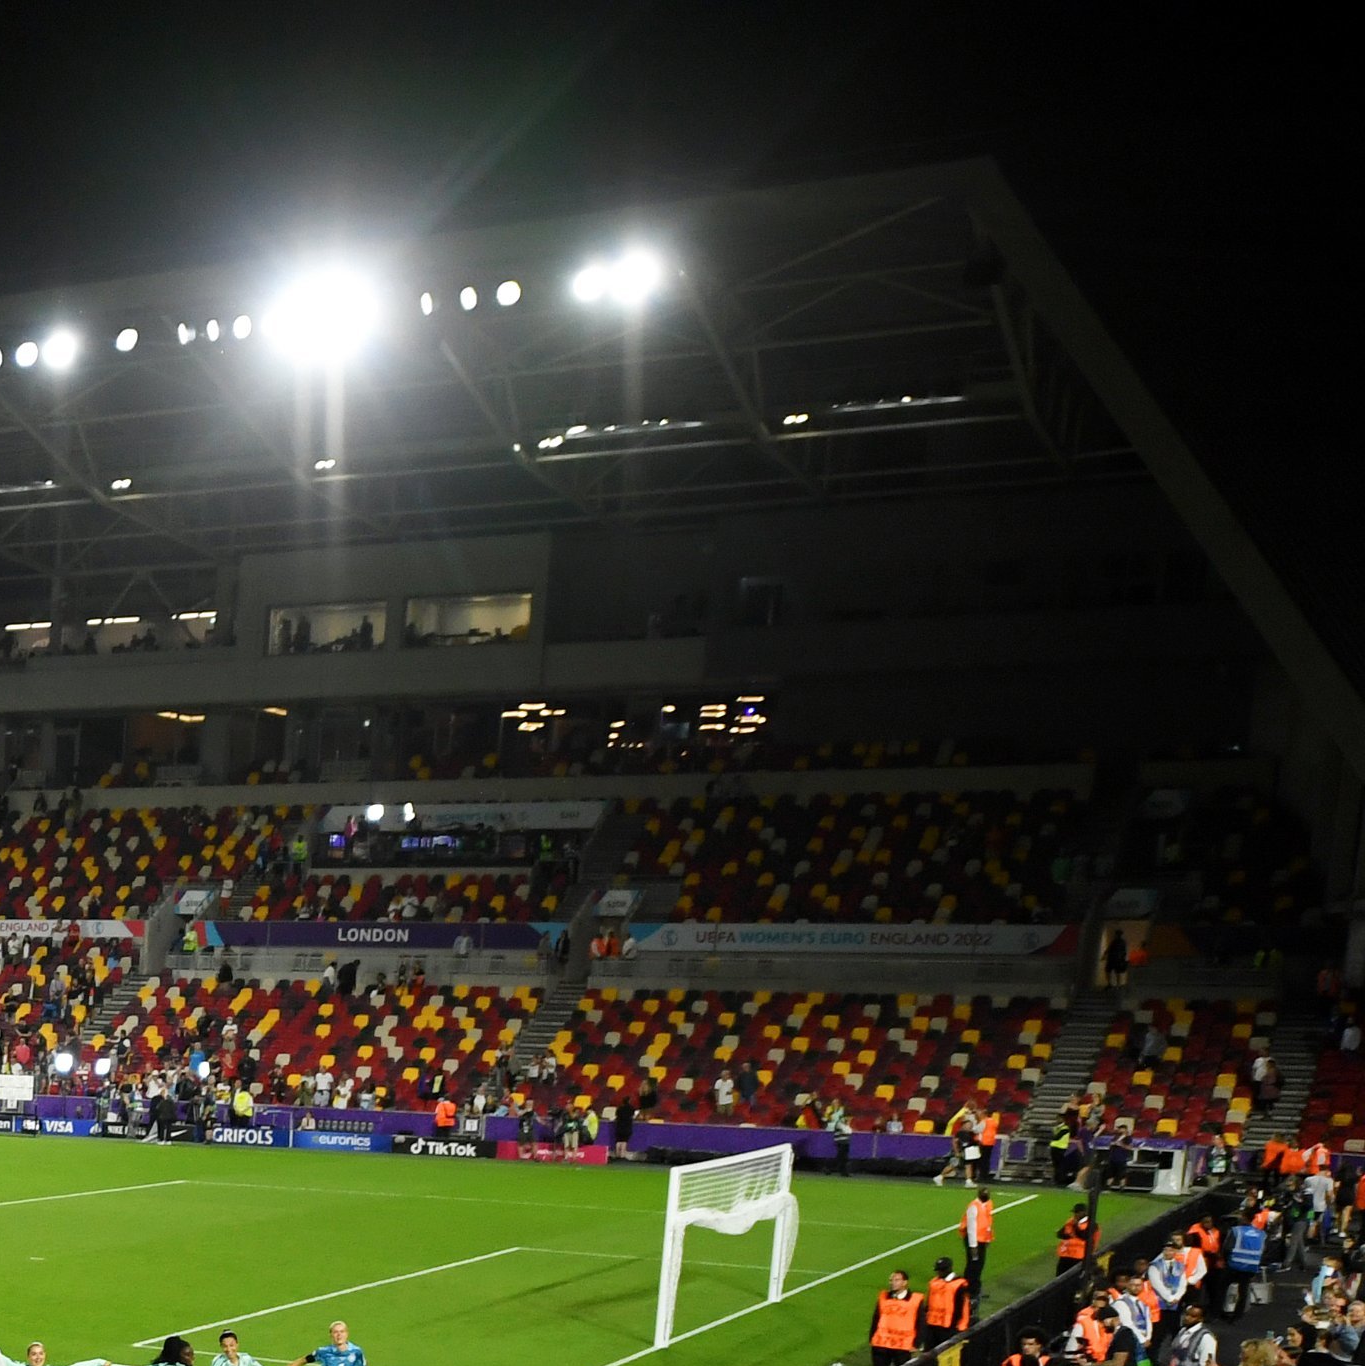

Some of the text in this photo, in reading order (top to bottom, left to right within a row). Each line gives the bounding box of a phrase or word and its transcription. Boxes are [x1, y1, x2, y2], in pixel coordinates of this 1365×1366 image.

[0, 922, 49, 932] ENGLAND
[337, 928, 410, 943] LONDON
[696, 930, 993, 946] UEFA WOMEN'S EURO ENGLAND 2022
[43, 1120, 73, 1133] VISA
[213, 1127, 274, 1145] GRIFOLS
[318, 1134, 372, 1147] euronics
[427, 1141, 477, 1157] TikTok
